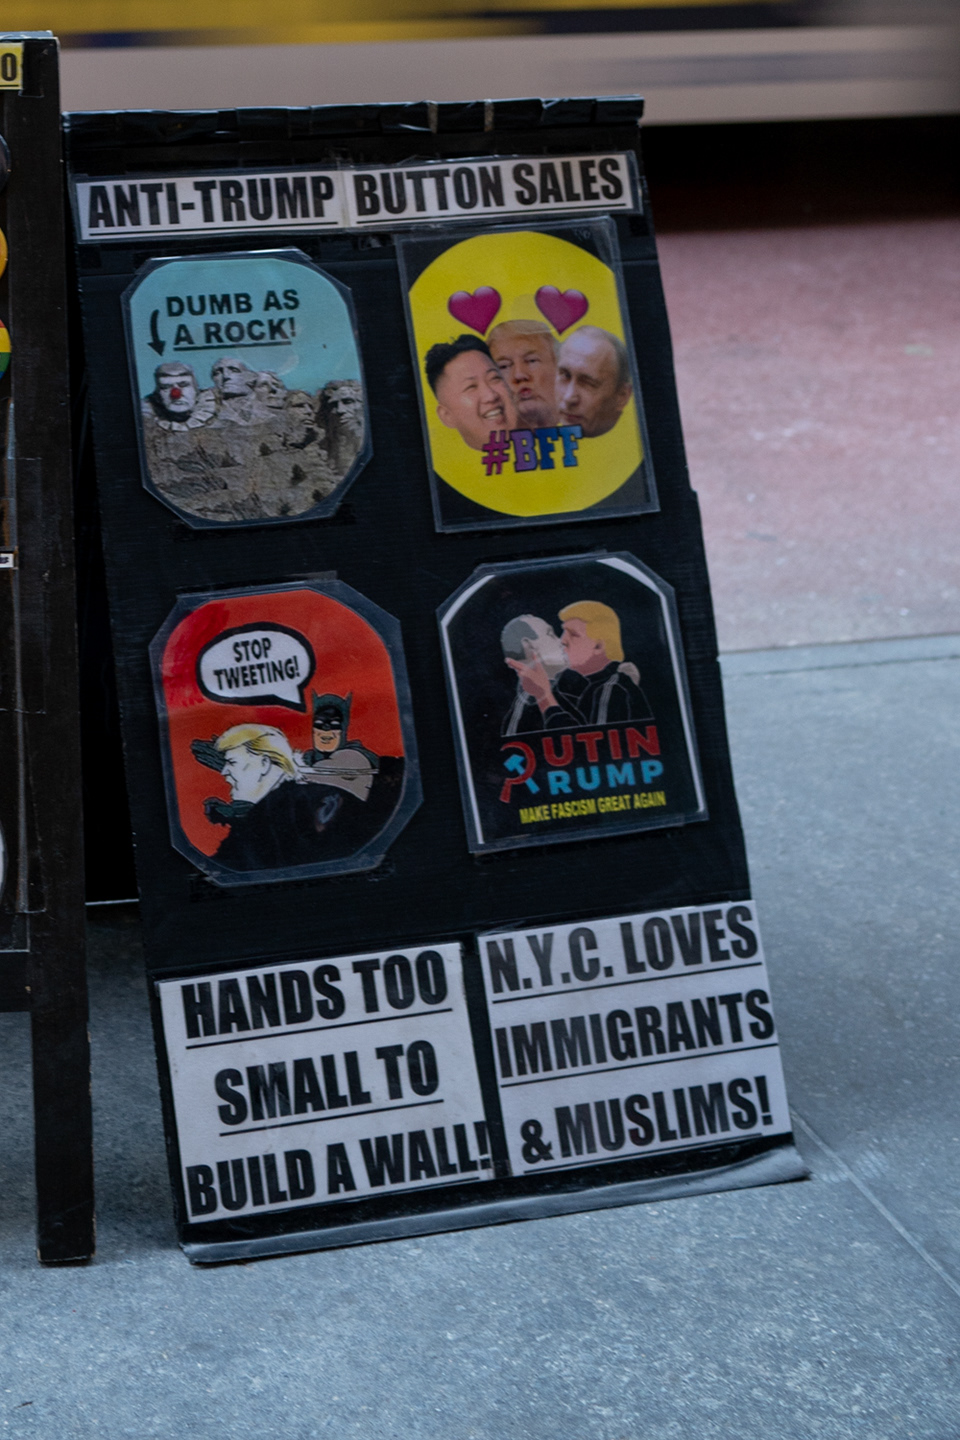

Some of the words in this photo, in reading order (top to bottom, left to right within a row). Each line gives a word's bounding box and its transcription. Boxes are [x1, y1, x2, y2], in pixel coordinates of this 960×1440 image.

[88, 174, 336, 229] ANTI-TRUMP
[353, 163, 505, 217] BUTTON
[514, 158, 624, 205] SALES
[165, 291, 253, 318] DUMB
[263, 288, 300, 311] AS
[174, 324, 194, 346] A
[204, 317, 297, 344] ROCK!
[481, 424, 583, 477] #BFF
[213, 655, 300, 691] TWEETING!
[233, 637, 272, 663] STOP
[519, 805, 550, 825] MAKE
[552, 798, 597, 819] FASCISM
[598, 794, 632, 814] GREAT
[633, 791, 666, 808] AGAIN
[485, 927, 614, 994] N.Y.C.
[619, 905, 759, 973] LOVES
[181, 964, 346, 1040] HANDS
[355, 950, 449, 1014] TOO
[494, 989, 776, 1079] IMMIGRANTS
[214, 1050, 372, 1126] SMALL
[376, 1040, 440, 1100] TO
[520, 1119, 554, 1164] &
[553, 1076, 775, 1155] MUSLIMS!
[185, 1148, 315, 1217] BUILD
[326, 1141, 359, 1194] A
[359, 1120, 492, 1189] WALL!
